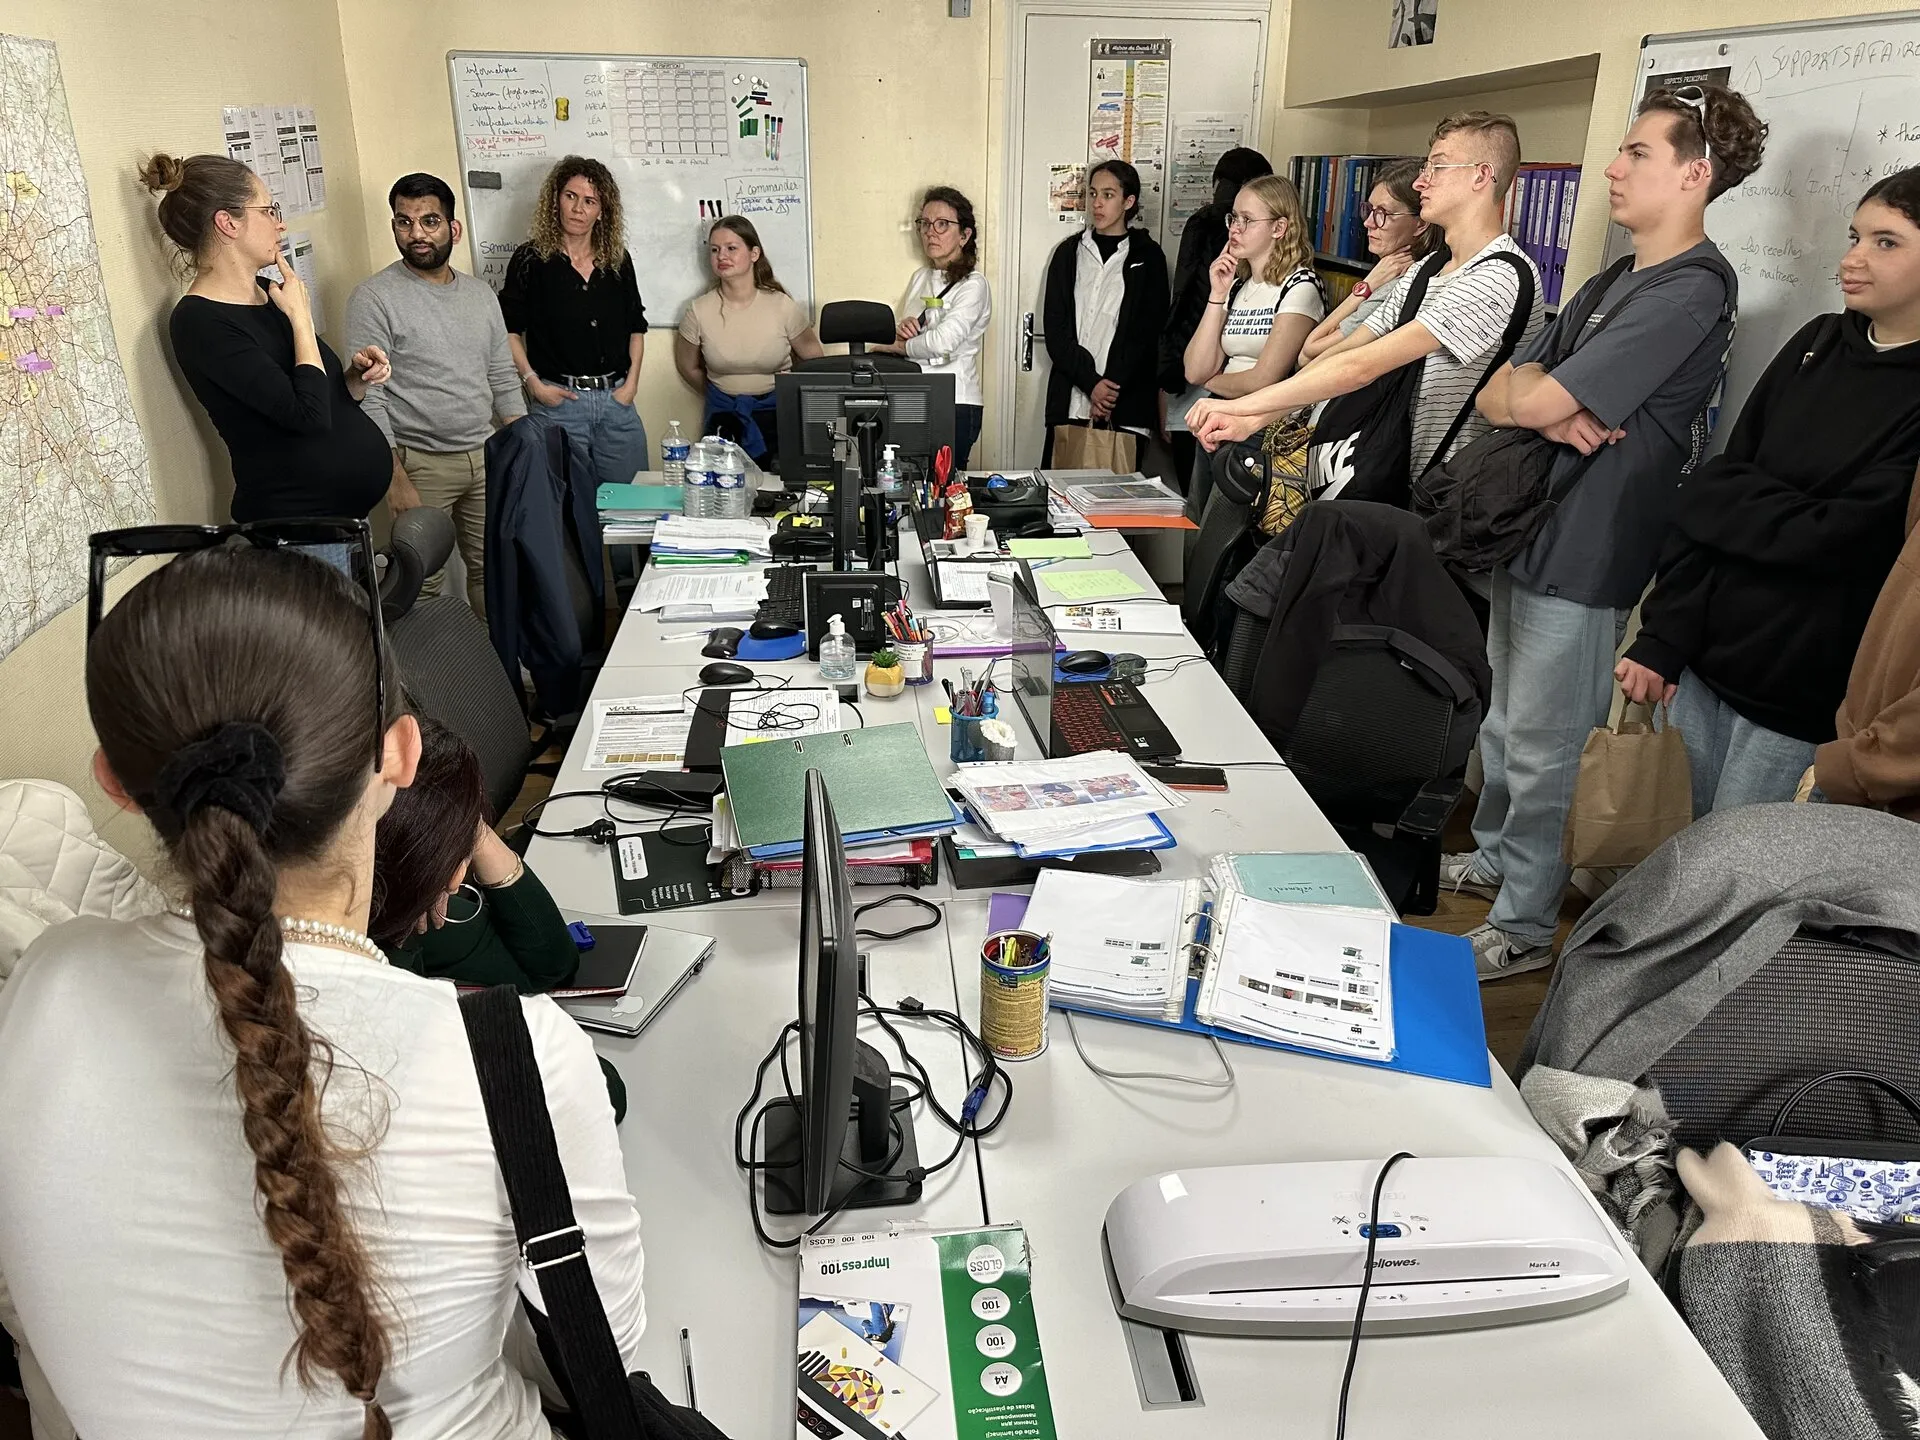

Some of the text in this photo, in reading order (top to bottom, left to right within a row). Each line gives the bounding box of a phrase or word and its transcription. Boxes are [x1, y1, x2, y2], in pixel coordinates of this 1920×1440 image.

[809, 1238, 836, 1246] GLOSS
[820, 1256, 890, 1276] Impress100
[969, 1260, 1003, 1273] GLOSS
[981, 1300, 1001, 1310] 100
[986, 1336, 1006, 1347] 100
[994, 1375, 1009, 1385] A4
